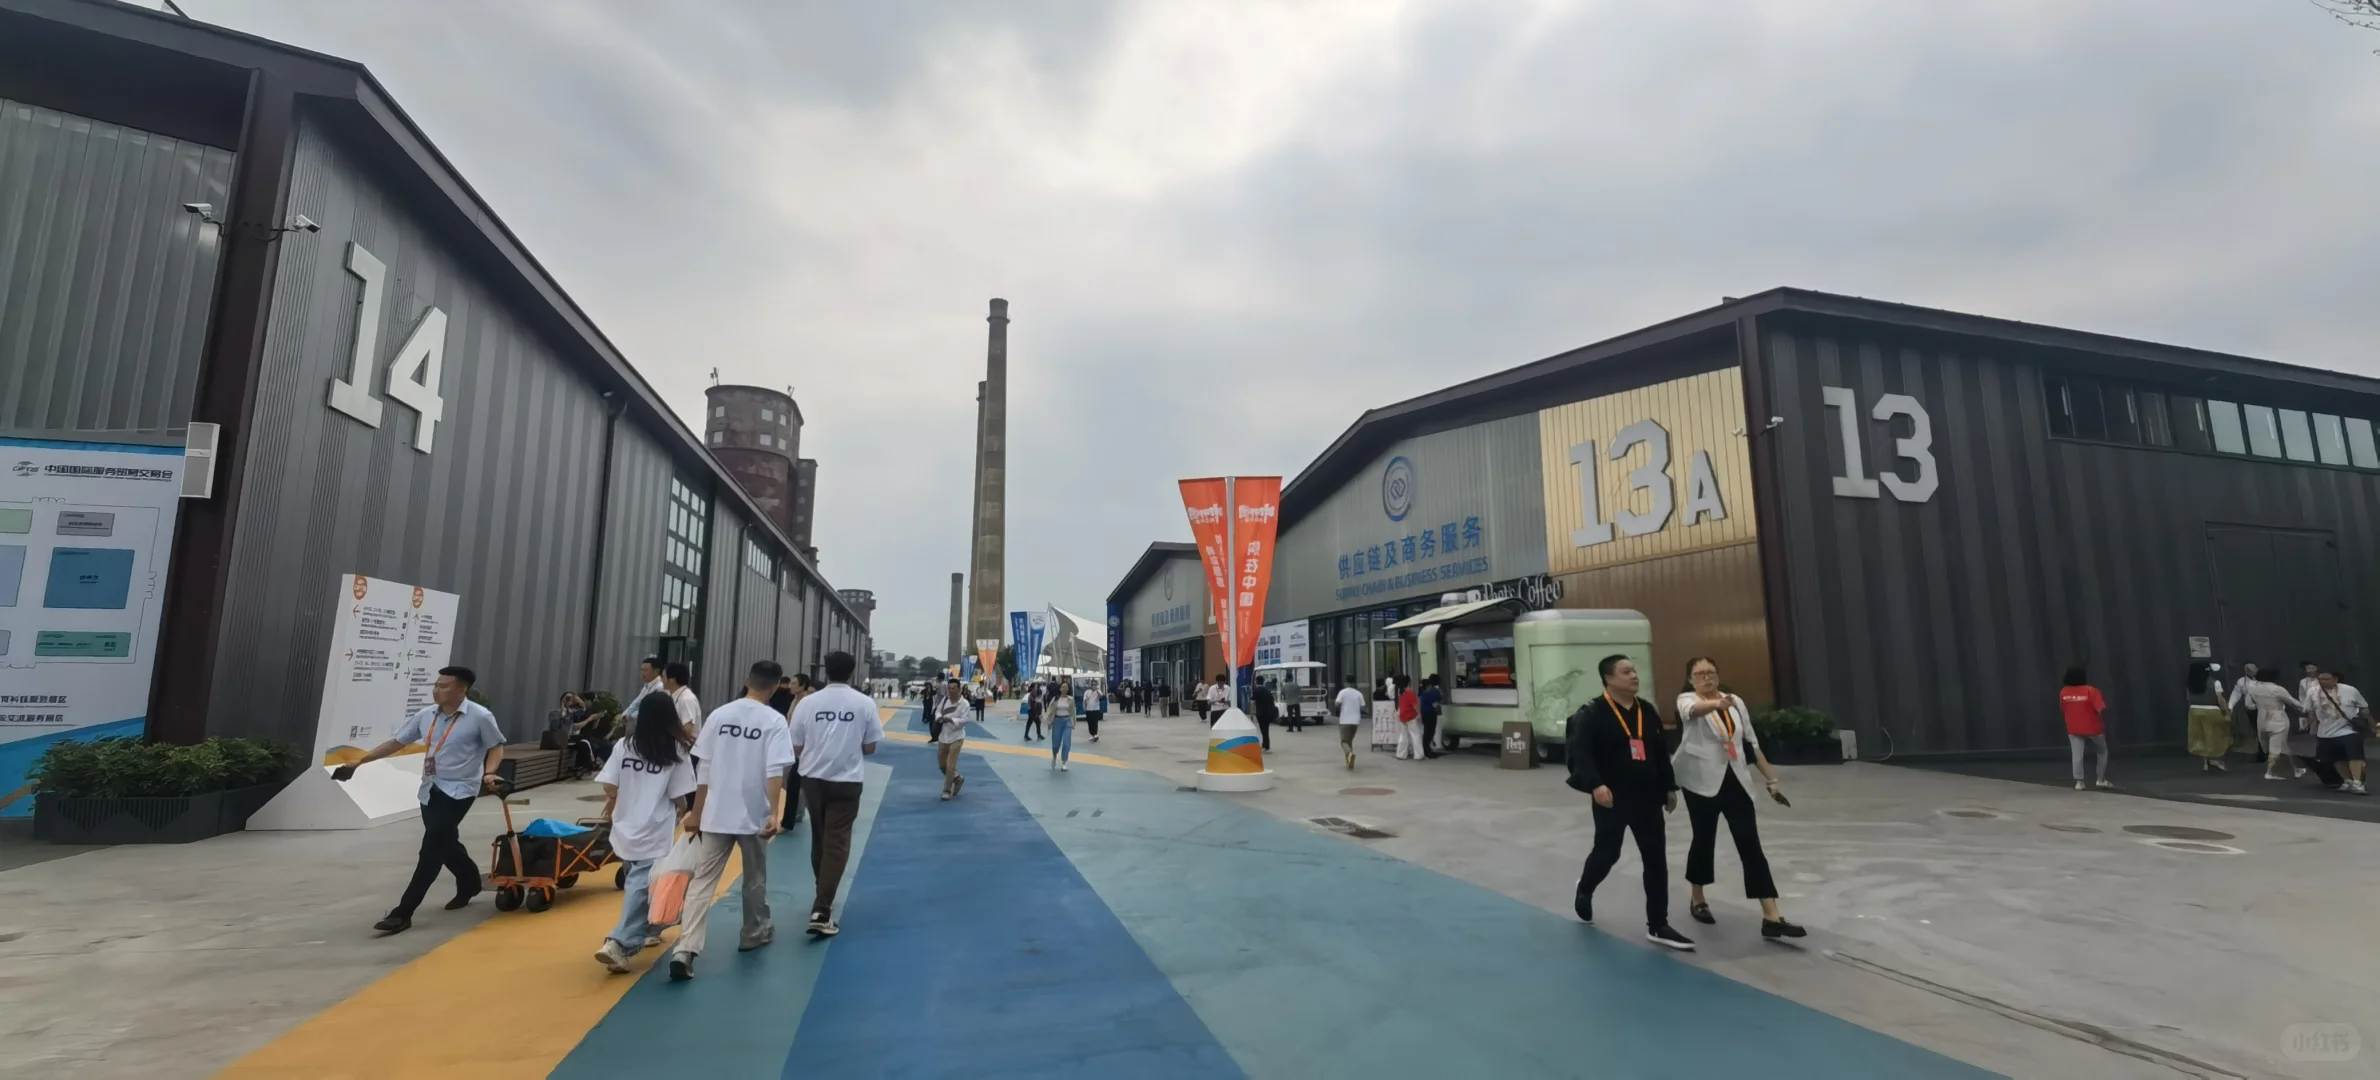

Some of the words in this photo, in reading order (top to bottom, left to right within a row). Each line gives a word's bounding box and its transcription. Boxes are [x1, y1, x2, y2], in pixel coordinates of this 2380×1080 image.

[327, 241, 447, 455] 14
[1569, 418, 1728, 549] 13A
[1822, 386, 1939, 502] 13
[1338, 516, 1481, 580] 供应链及商务服务
[1395, 566, 1438, 589] BUSINESS
[1440, 555, 1489, 580] SERVICES
[1518, 574, 1561, 609] Coffee
